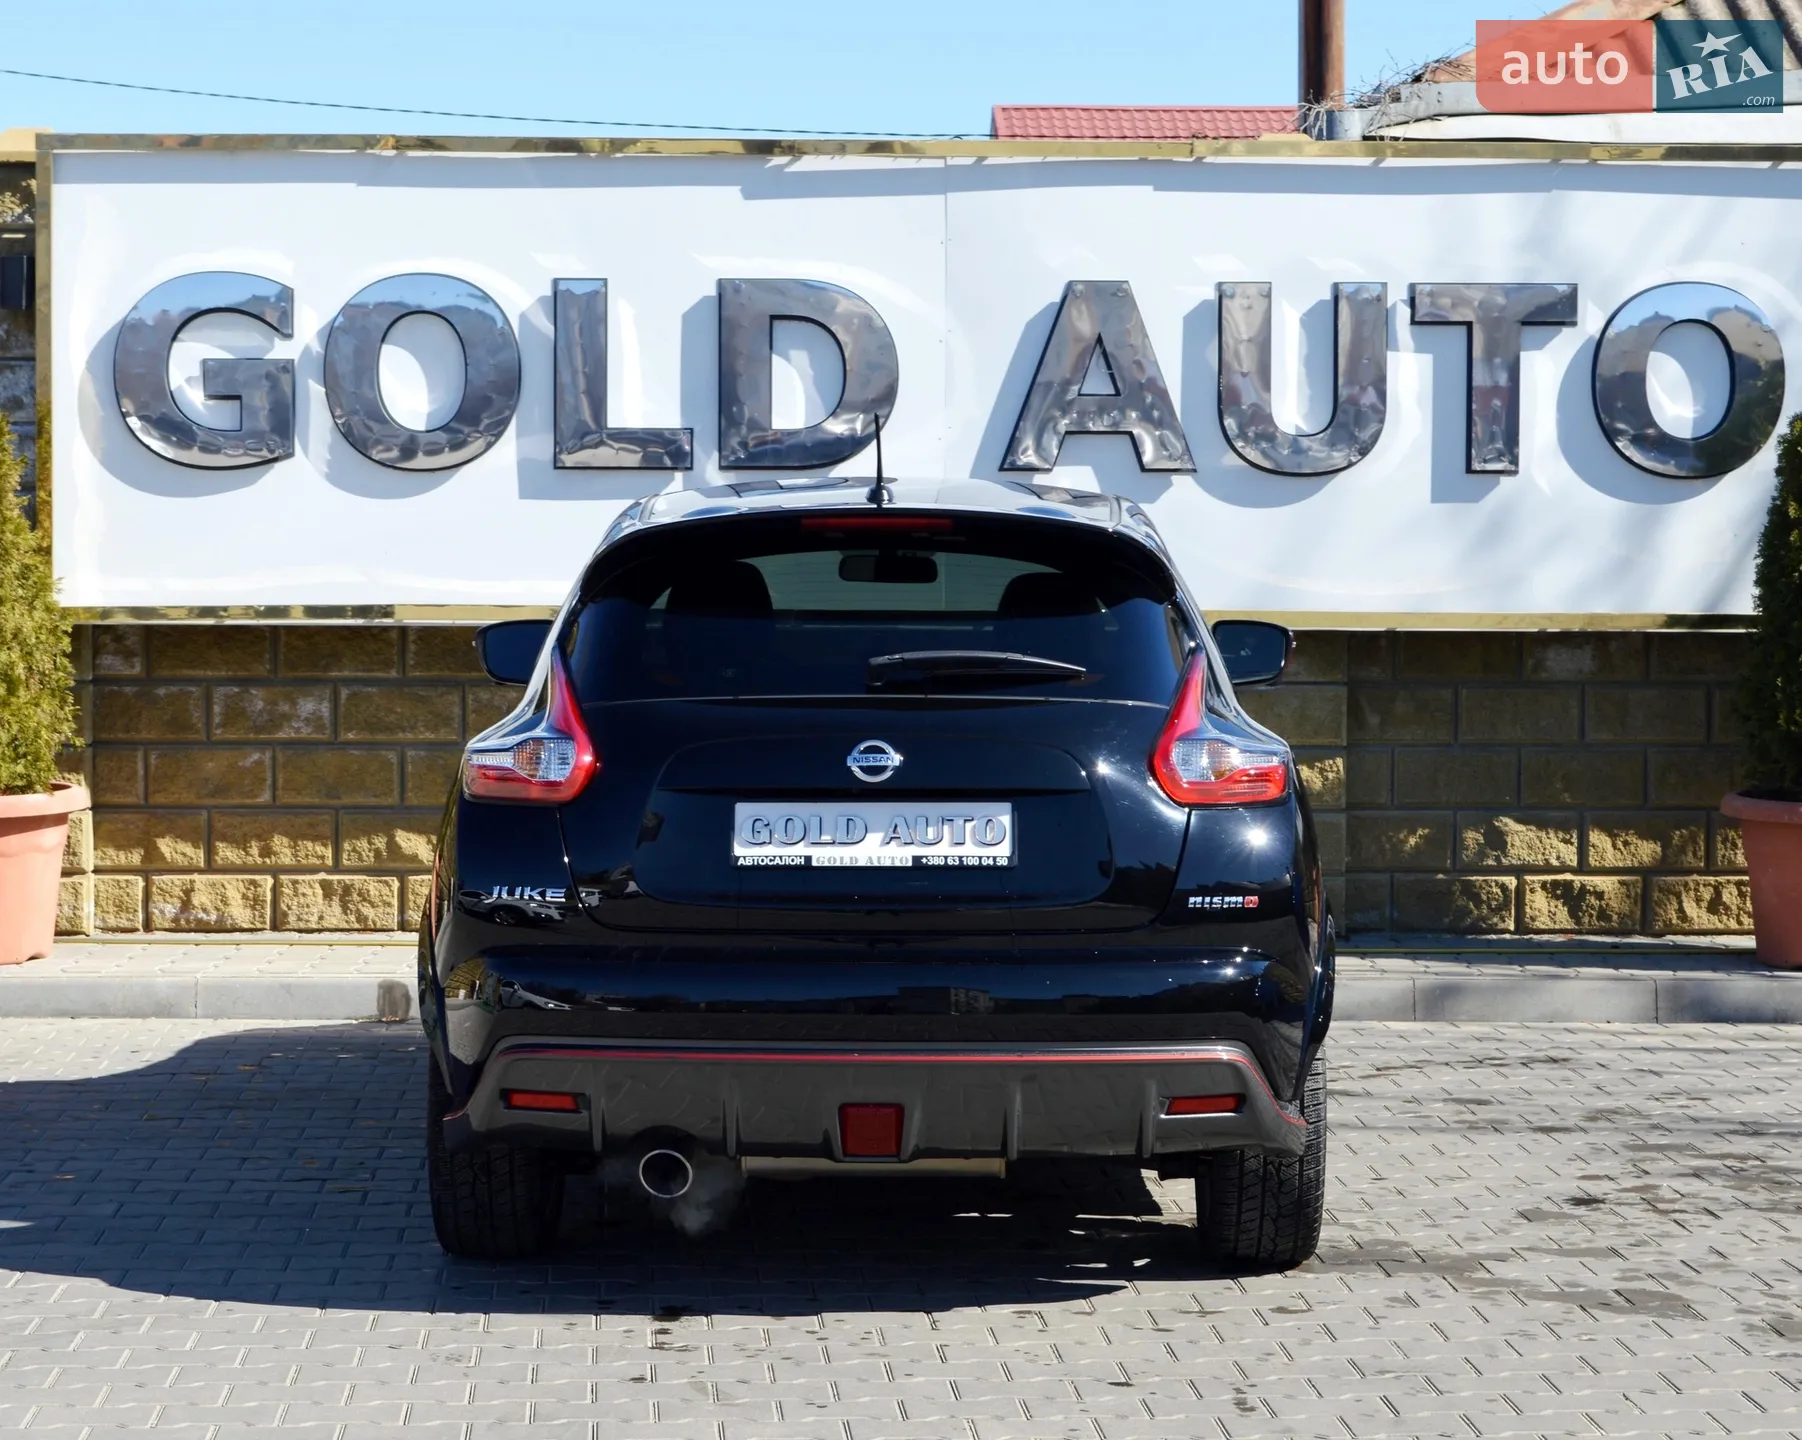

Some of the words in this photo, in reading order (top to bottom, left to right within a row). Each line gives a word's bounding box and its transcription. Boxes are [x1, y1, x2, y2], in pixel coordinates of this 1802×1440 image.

[113, 270, 899, 471] GOLD
[999, 281, 1786, 479] AUTO
[853, 756, 894, 764] NISSAN
[740, 815, 868, 846] GOLD
[882, 815, 1007, 846] AUTO
[737, 856, 805, 866] АВТОСАЛОН
[815, 856, 860, 866] GOLD
[864, 856, 910, 866] AUTO
[921, 857, 945, 866] +380
[947, 857, 960, 866] 63
[962, 857, 979, 866] 100
[981, 857, 994, 866] 04
[996, 857, 1008, 866] 50
[484, 885, 566, 903] JUKE
